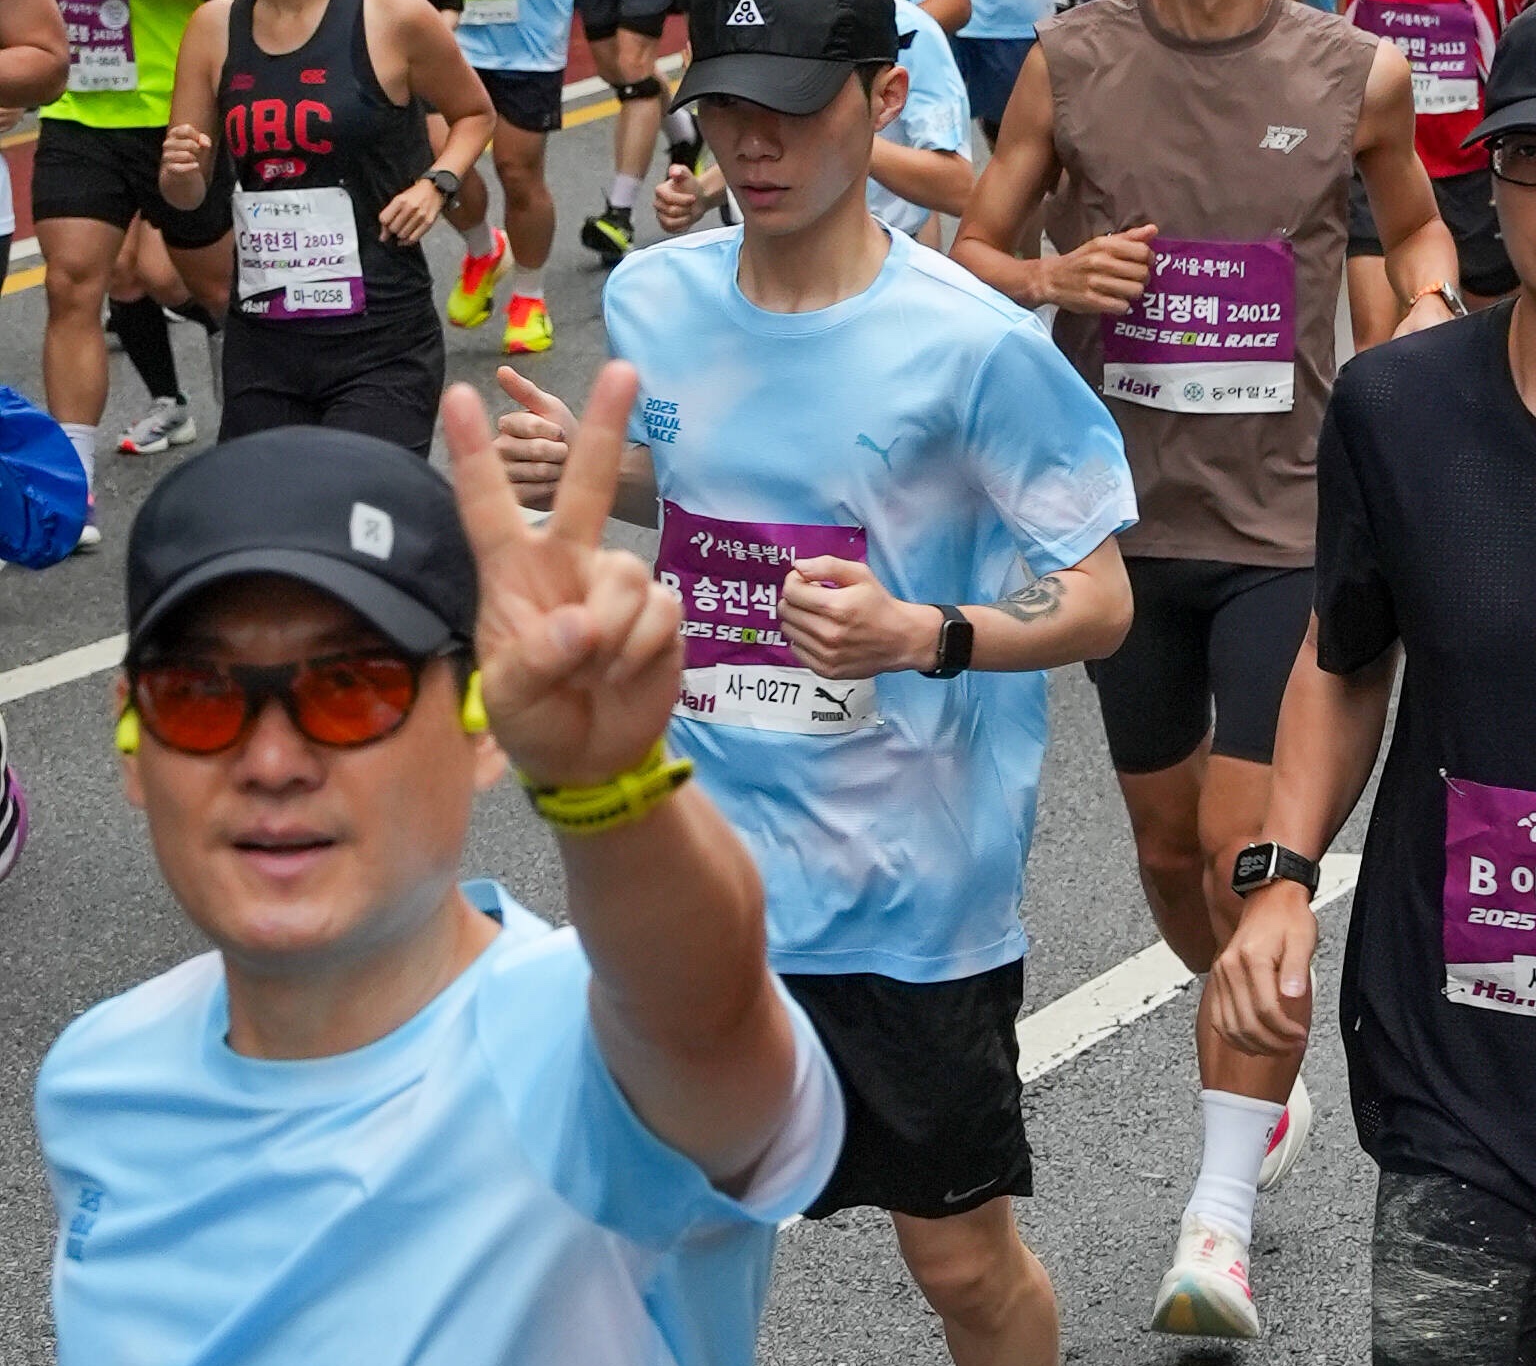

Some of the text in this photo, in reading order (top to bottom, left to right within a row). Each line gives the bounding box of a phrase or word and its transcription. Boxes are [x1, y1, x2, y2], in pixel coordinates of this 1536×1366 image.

[249, 230, 298, 253] 정현희
[303, 233, 345, 249] 28019
[307, 255, 346, 267] RACE
[1171, 257, 1246, 278] 서울특별시
[293, 288, 344, 304] 마-0258
[1142, 292, 1282, 325] 김정혜 24012
[1113, 321, 1280, 348] 2025 SEOUL RACE
[1117, 376, 1162, 399] Half
[1210, 386, 1279, 402] 동아일보
[646, 397, 680, 415] 2025
[716, 538, 796, 567] 서울특별시
[691, 575, 778, 620] 송진석
[679, 621, 788, 648] 025 SEOUL
[725, 674, 801, 707] 사-0277
[1468, 854, 1498, 896] B
